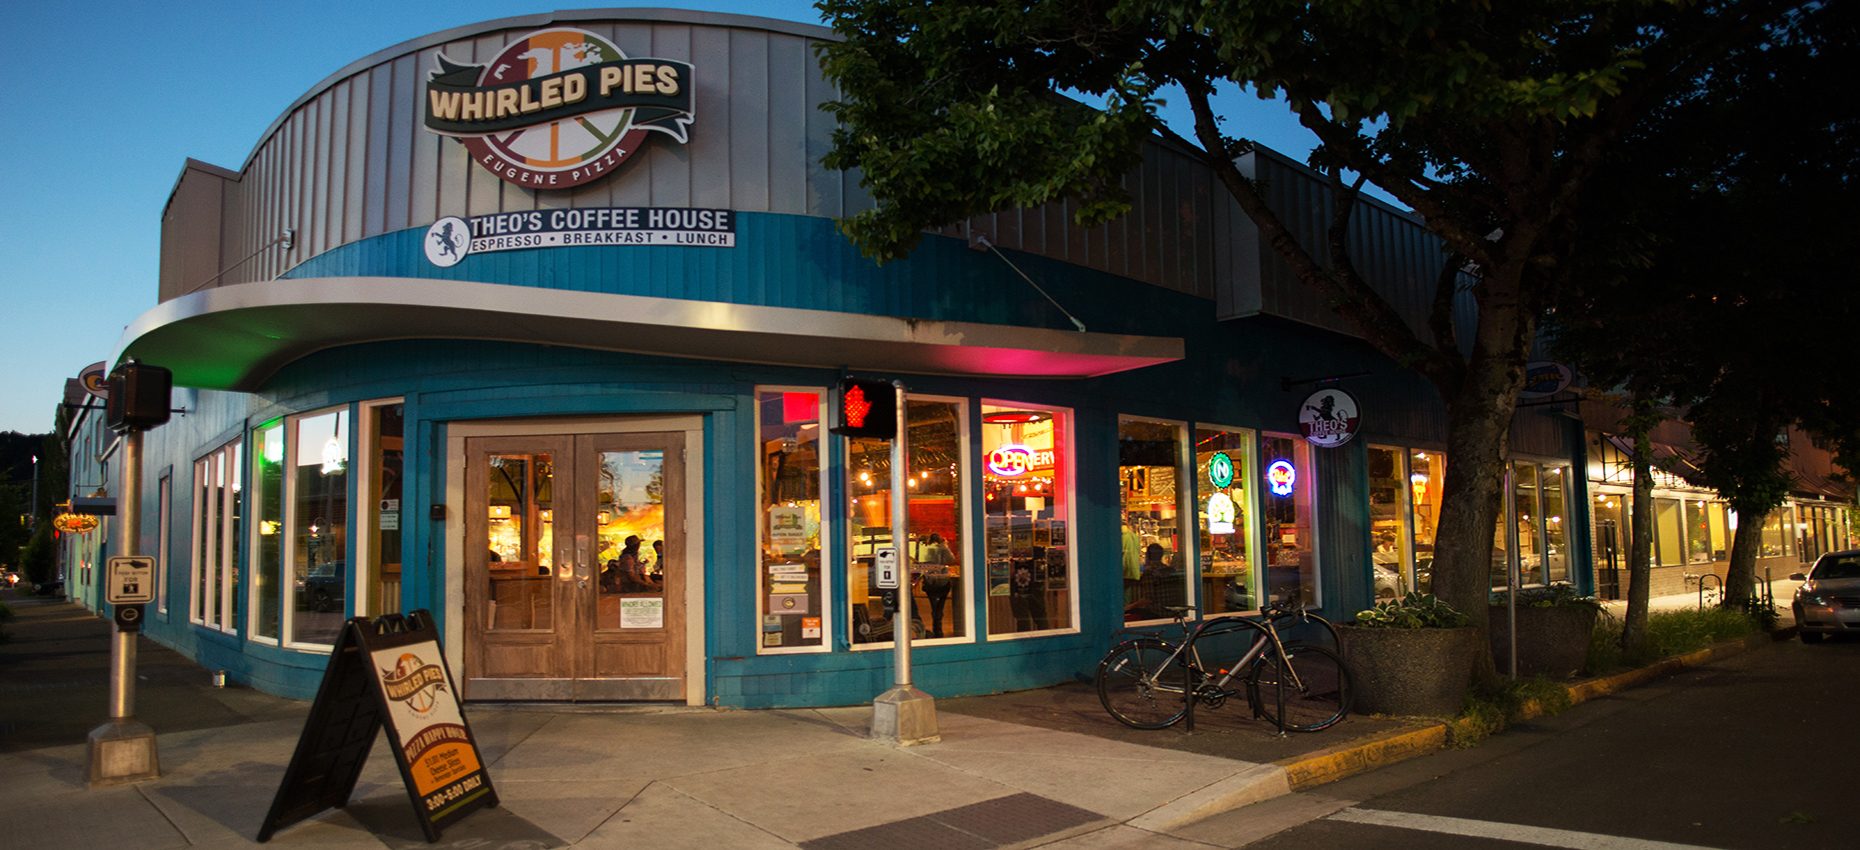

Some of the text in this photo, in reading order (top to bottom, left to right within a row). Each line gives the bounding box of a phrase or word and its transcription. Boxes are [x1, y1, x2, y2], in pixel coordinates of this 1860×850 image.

[430, 64, 681, 121] WHIRLED PIES
[484, 147, 627, 185] EUGENE PIZZA
[470, 209, 729, 235] THEO'S COFFEE HOUSE
[472, 232, 728, 251] ESPRESSO BREAKFAST LUNCH
[1309, 419, 1348, 432] THEO'S
[990, 449, 1034, 471] OPEN
[386, 666, 443, 699] WHIRLED PIES
[406, 739, 426, 763] PIZZA
[424, 728, 446, 746] HAPPY
[429, 757, 462, 776] Cheese Slices
[463, 774, 482, 792] DAILY
